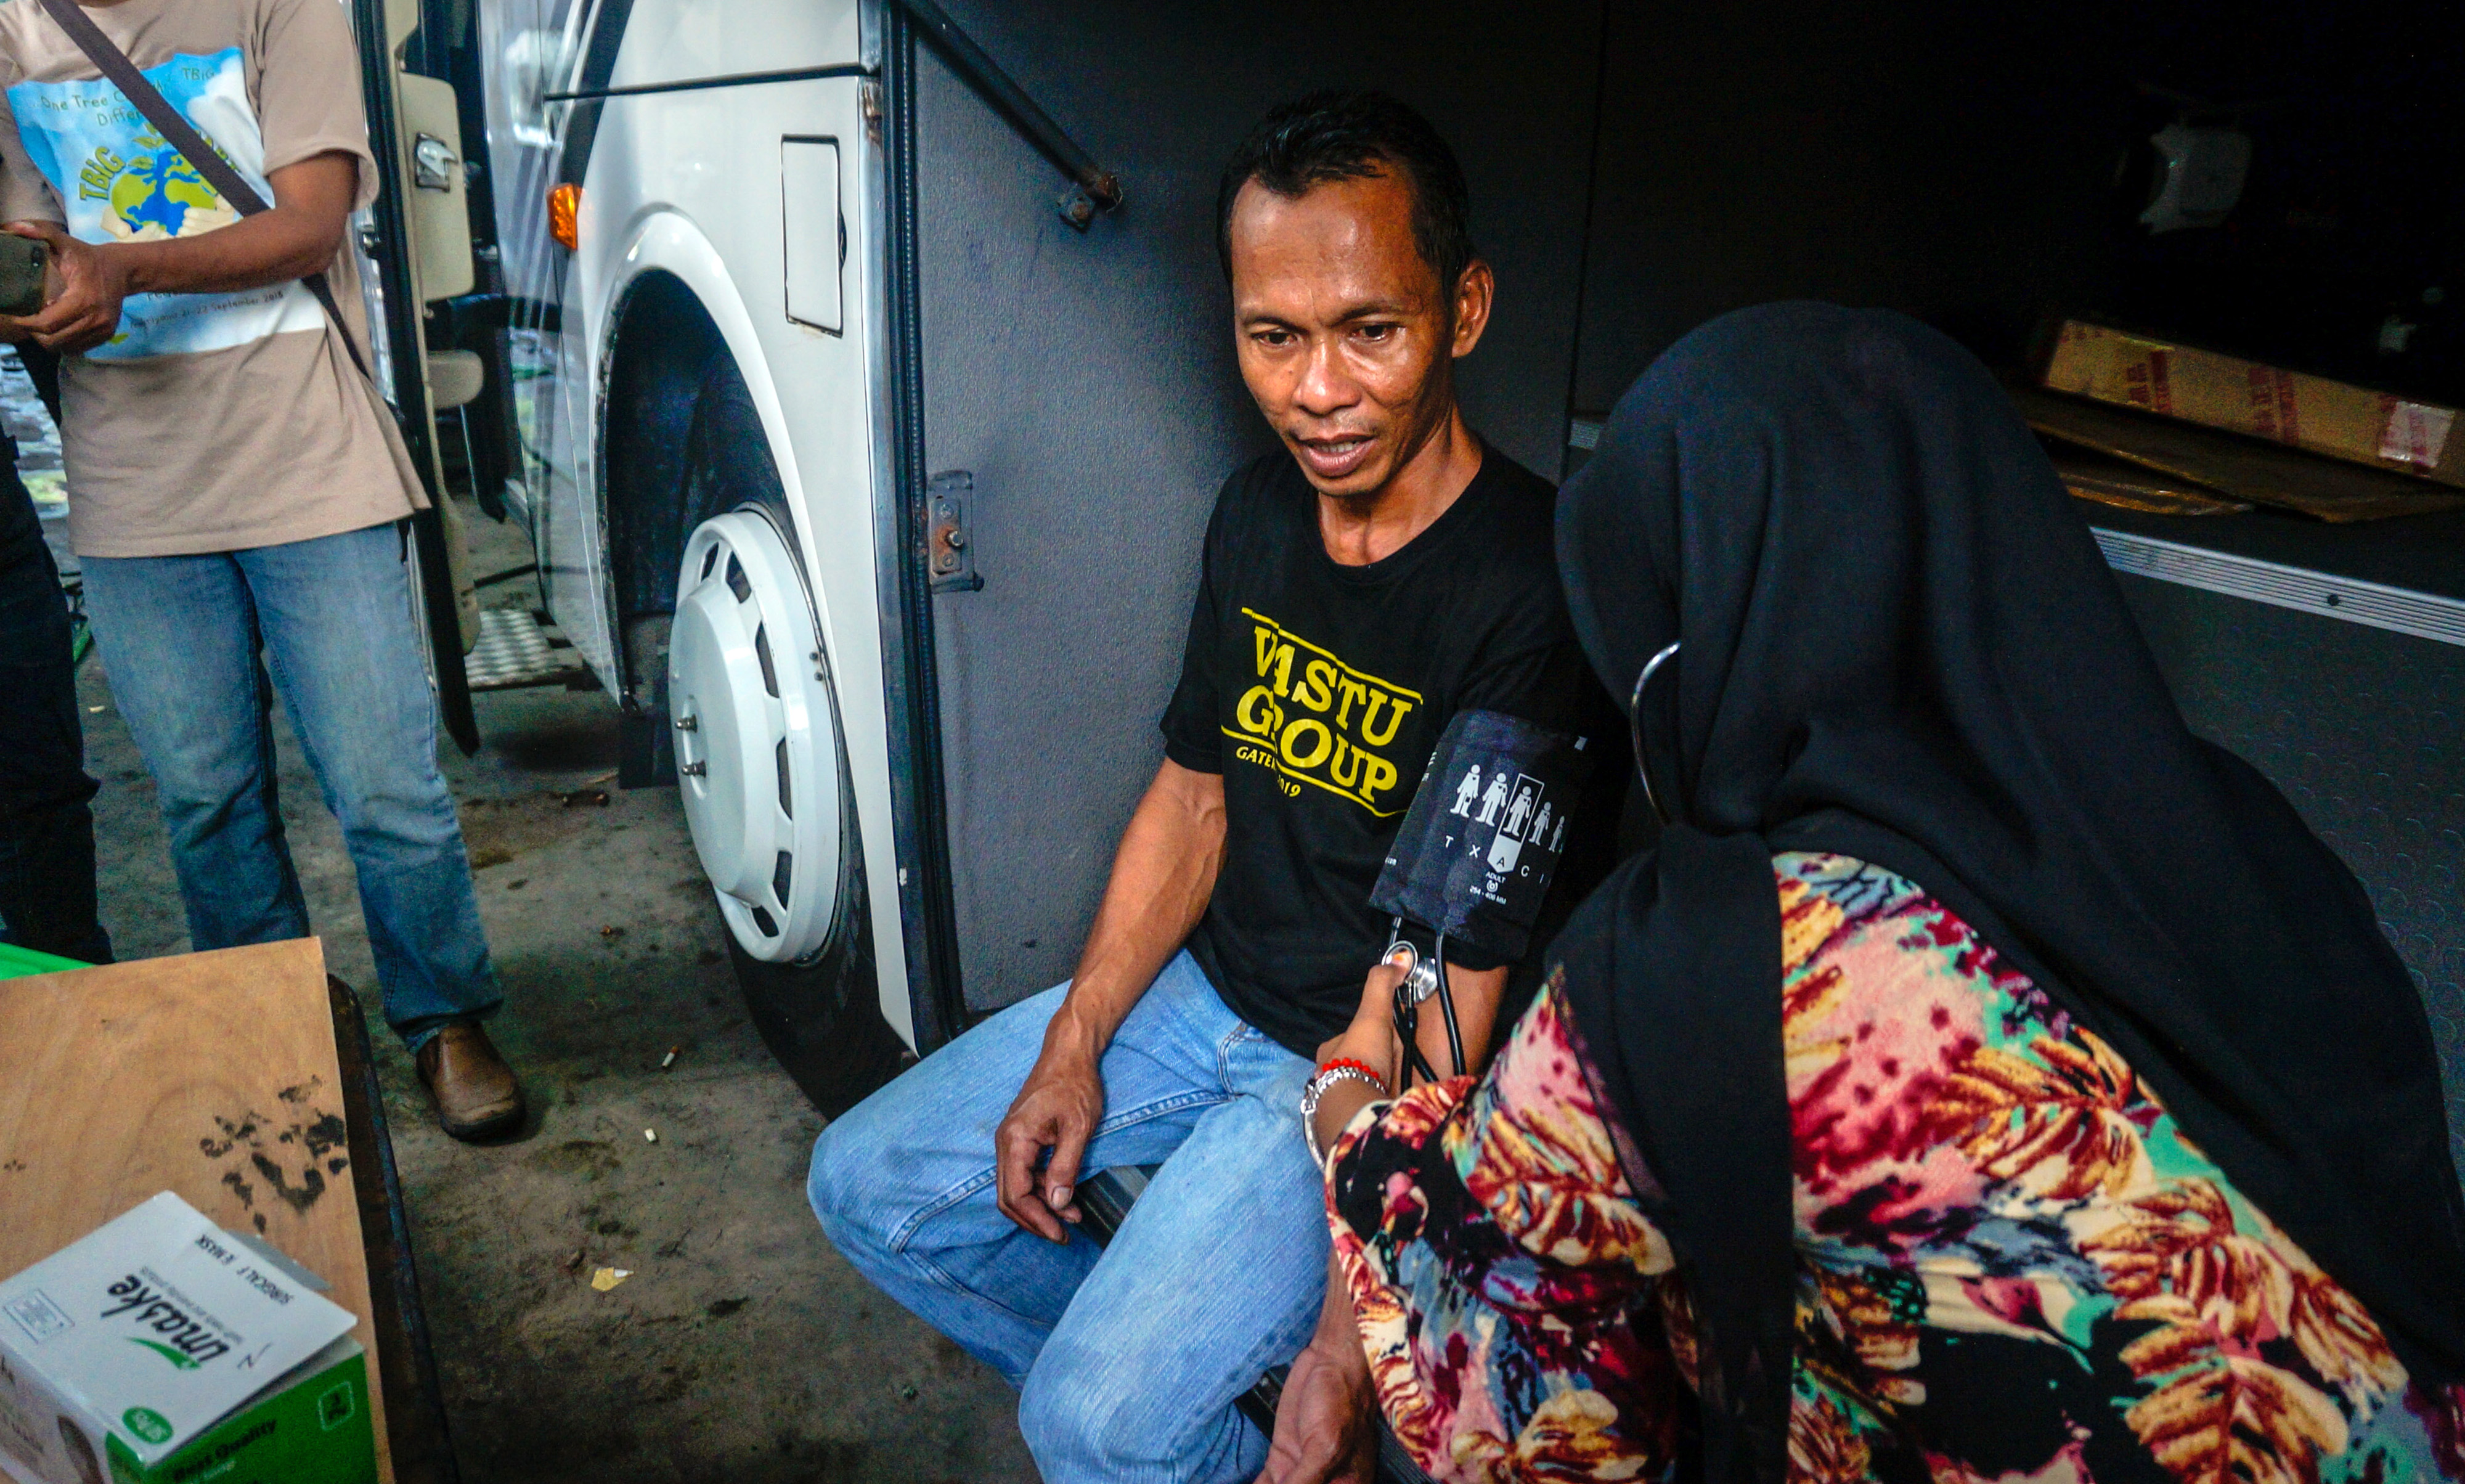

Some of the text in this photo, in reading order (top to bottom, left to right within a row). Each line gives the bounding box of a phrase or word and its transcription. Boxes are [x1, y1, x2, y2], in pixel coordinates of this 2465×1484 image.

[41, 95, 68, 112] One
[71, 94, 108, 108] Tree
[79, 146, 126, 201] TBiG
[1445, 834, 1454, 848] T
[1469, 844, 1481, 858] X
[1496, 856, 1505, 868] A
[1520, 865, 1530, 878] C
[1485, 870, 1506, 884] ADULT
